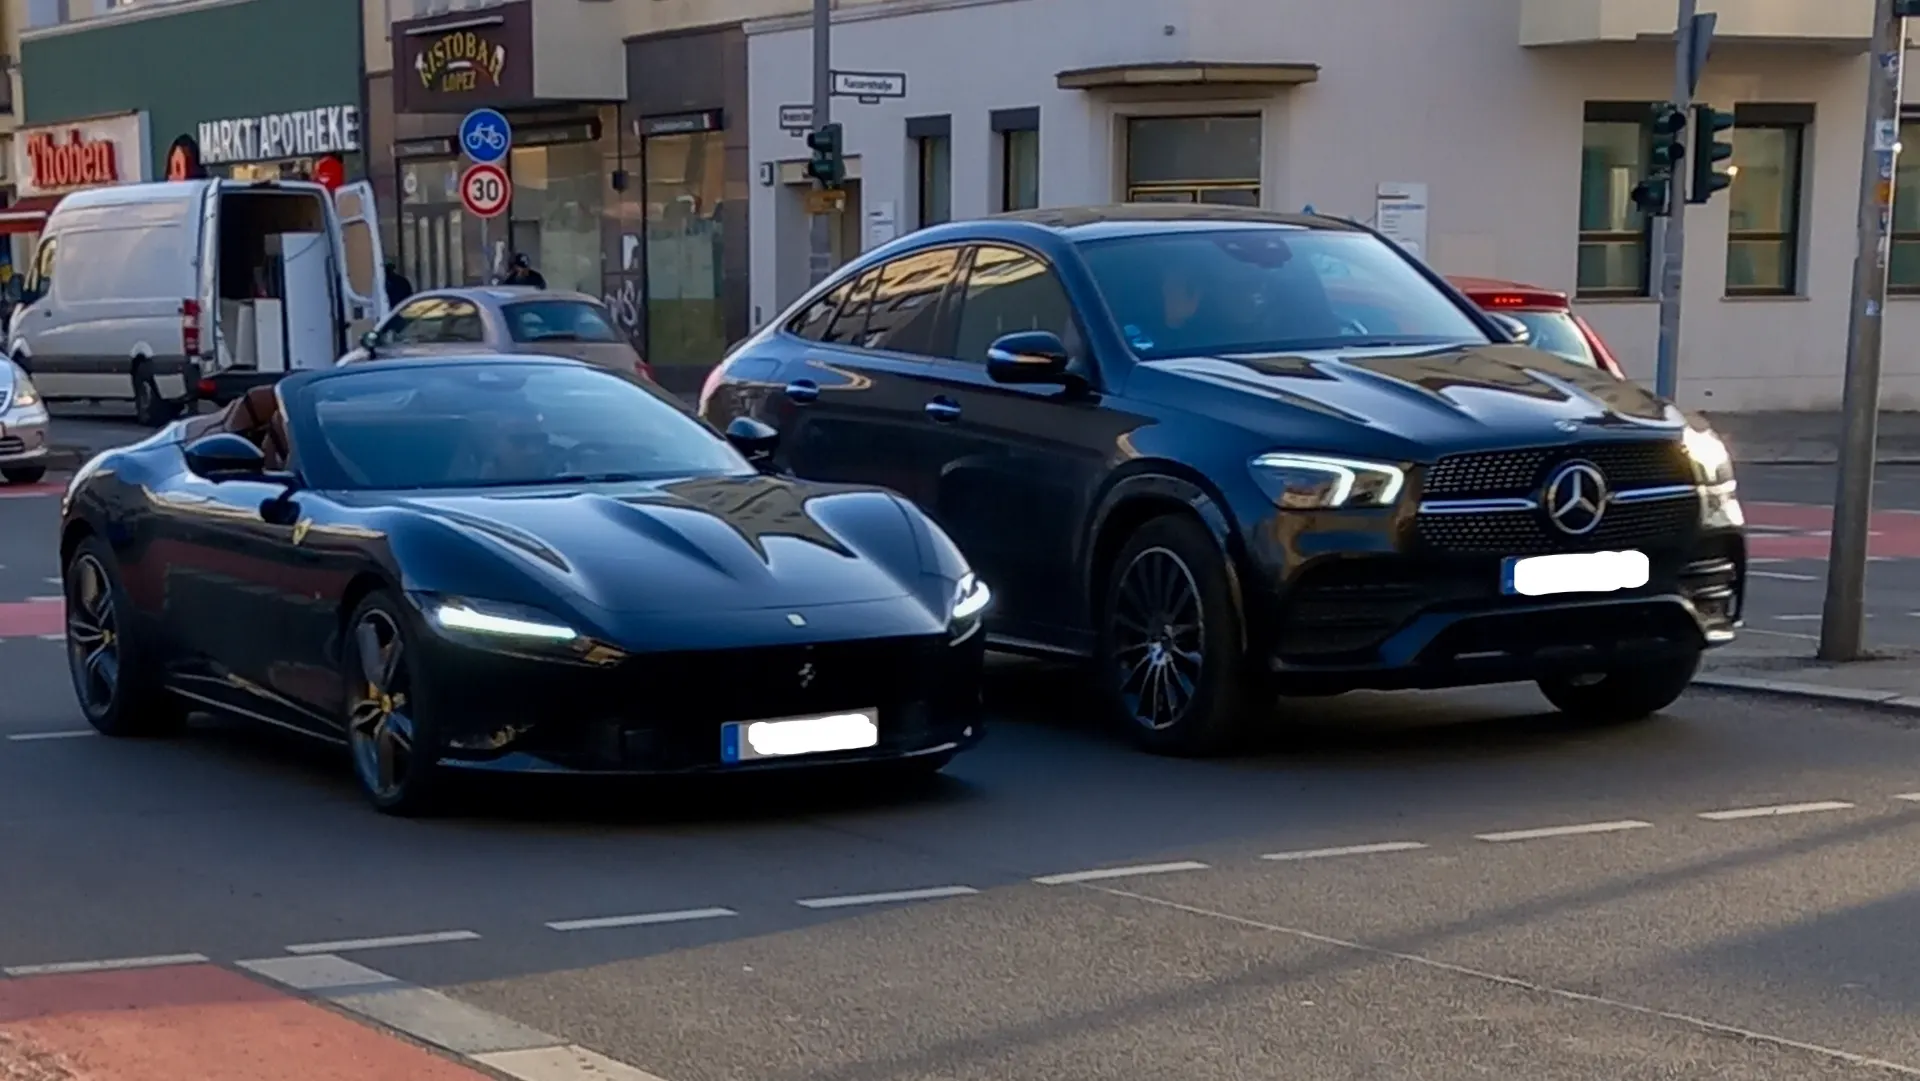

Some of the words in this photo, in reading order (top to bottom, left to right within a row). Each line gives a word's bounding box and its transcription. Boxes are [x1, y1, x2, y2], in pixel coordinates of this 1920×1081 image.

[27, 130, 116, 187] Thoben
[199, 118, 254, 164] MARKT
[259, 105, 357, 158] APOTHEKE
[472, 178, 499, 201] 30
